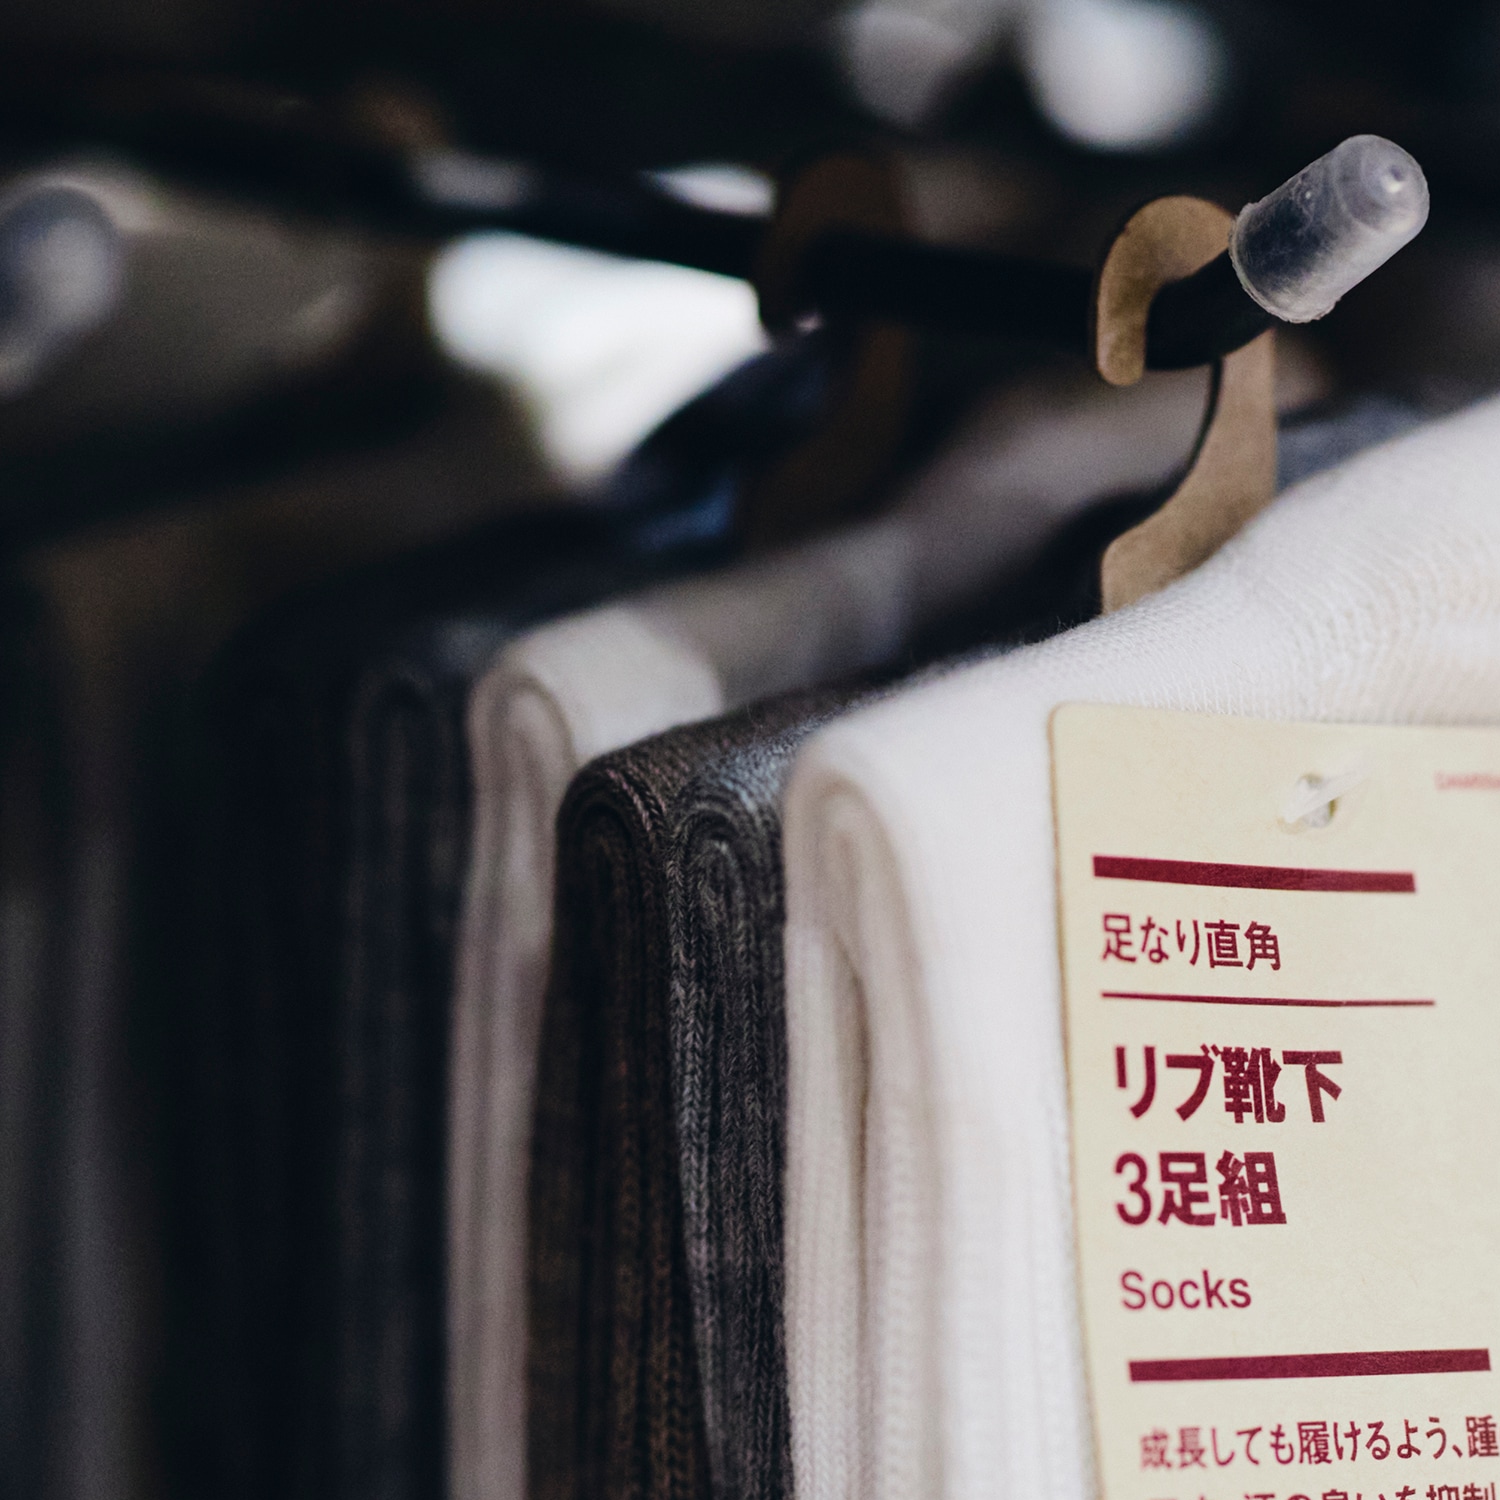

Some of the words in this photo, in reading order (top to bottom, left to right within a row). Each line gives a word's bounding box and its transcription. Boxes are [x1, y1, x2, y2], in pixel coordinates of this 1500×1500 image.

[1101, 913, 1282, 971] 足なり直角
[1115, 1043, 1344, 1125] リブ靴下
[1114, 1149, 1288, 1227] 3足組
[1121, 1269, 1252, 1310] Socks
